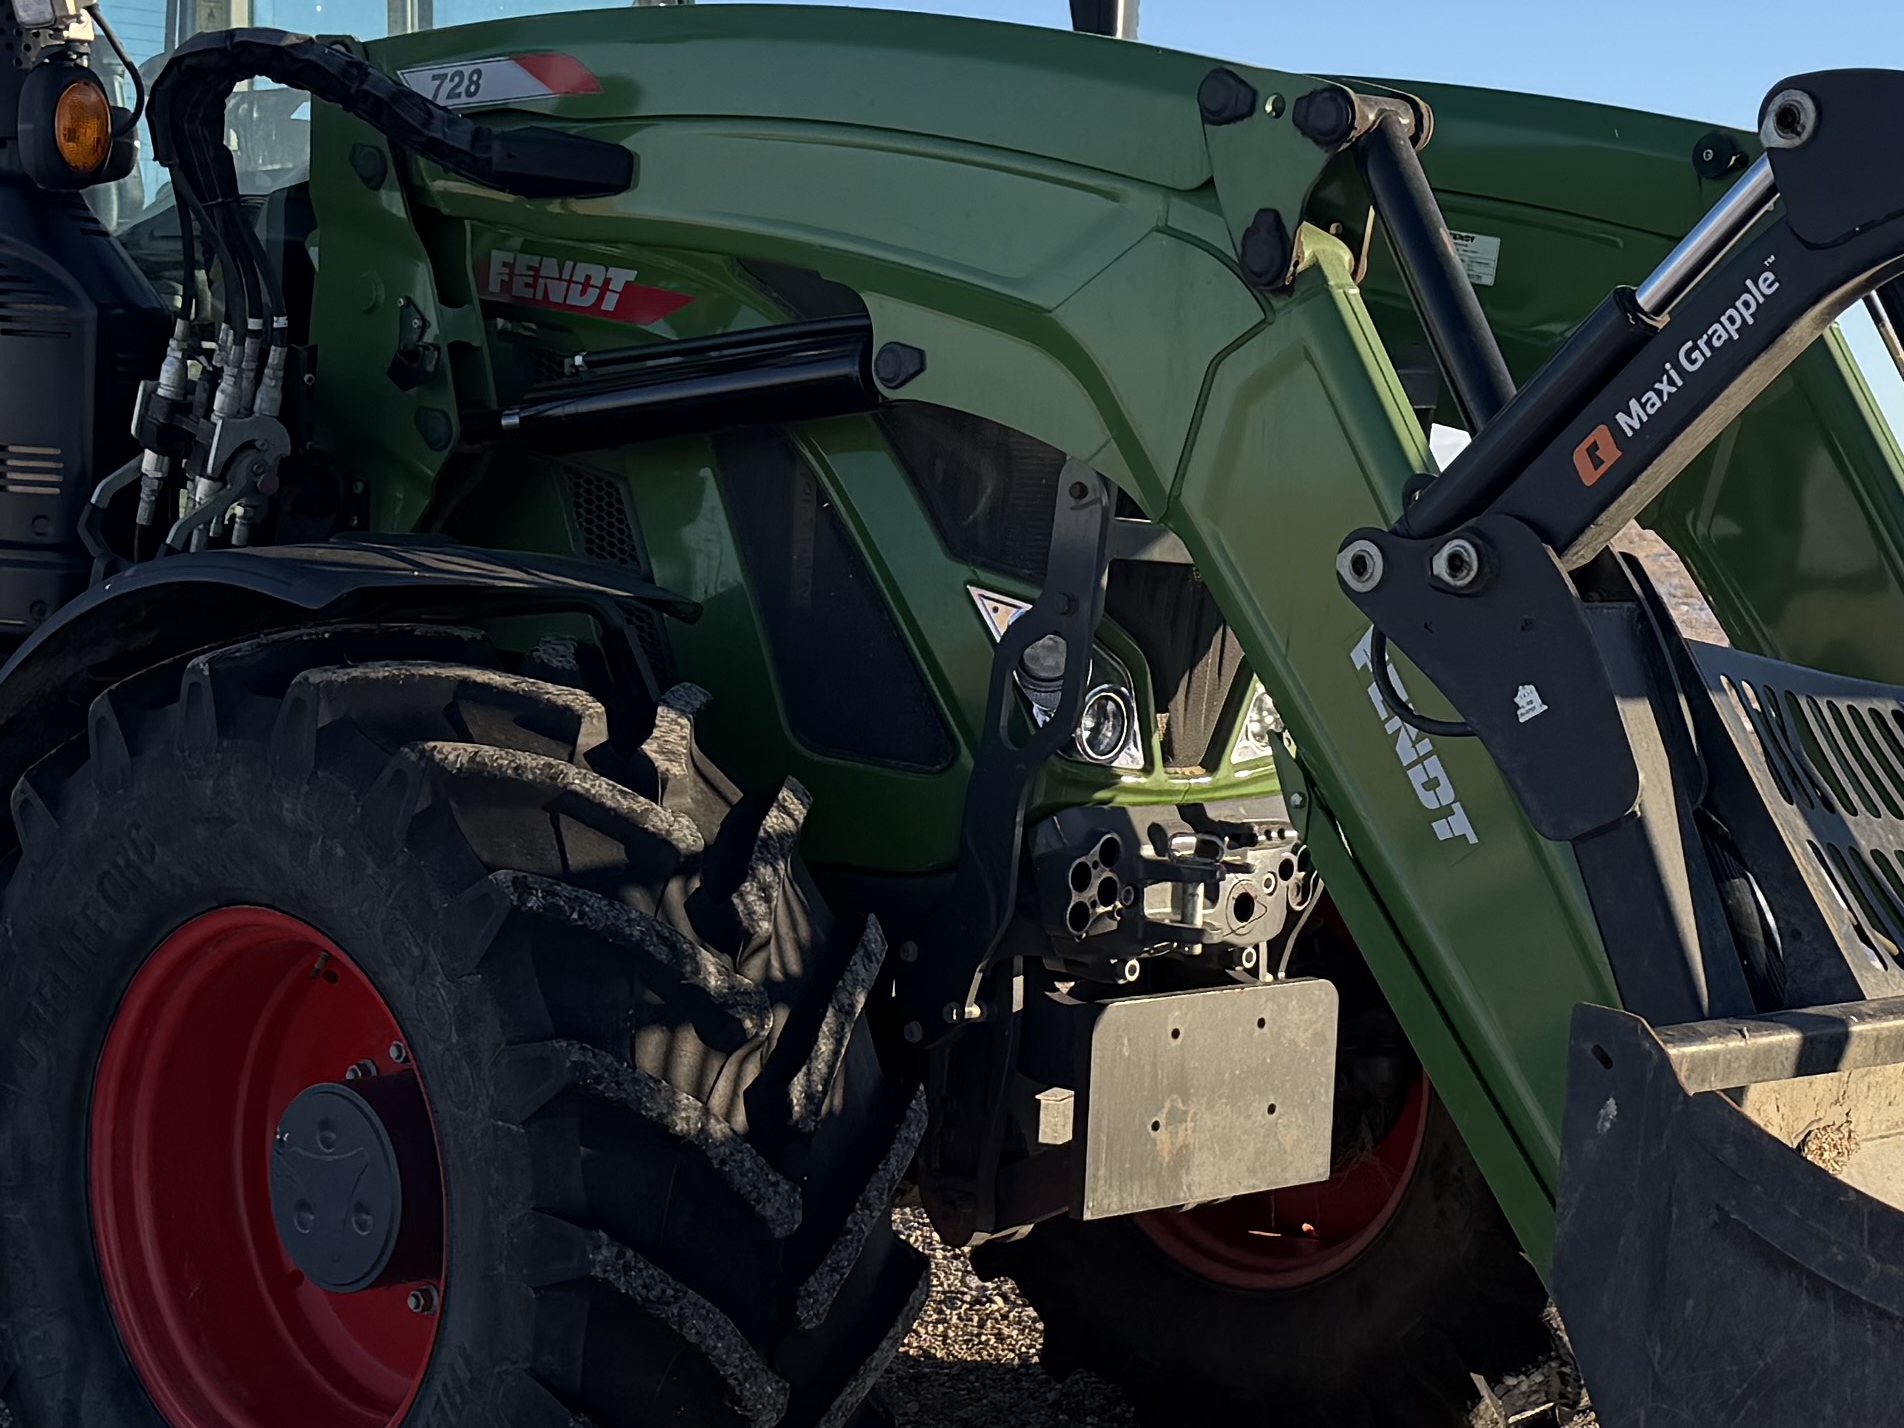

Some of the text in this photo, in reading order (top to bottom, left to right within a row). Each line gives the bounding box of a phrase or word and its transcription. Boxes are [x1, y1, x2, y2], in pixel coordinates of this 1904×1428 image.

[431, 68, 483, 102] 728
[488, 249, 638, 312] FENDT
[1615, 362, 1684, 438] Maxi
